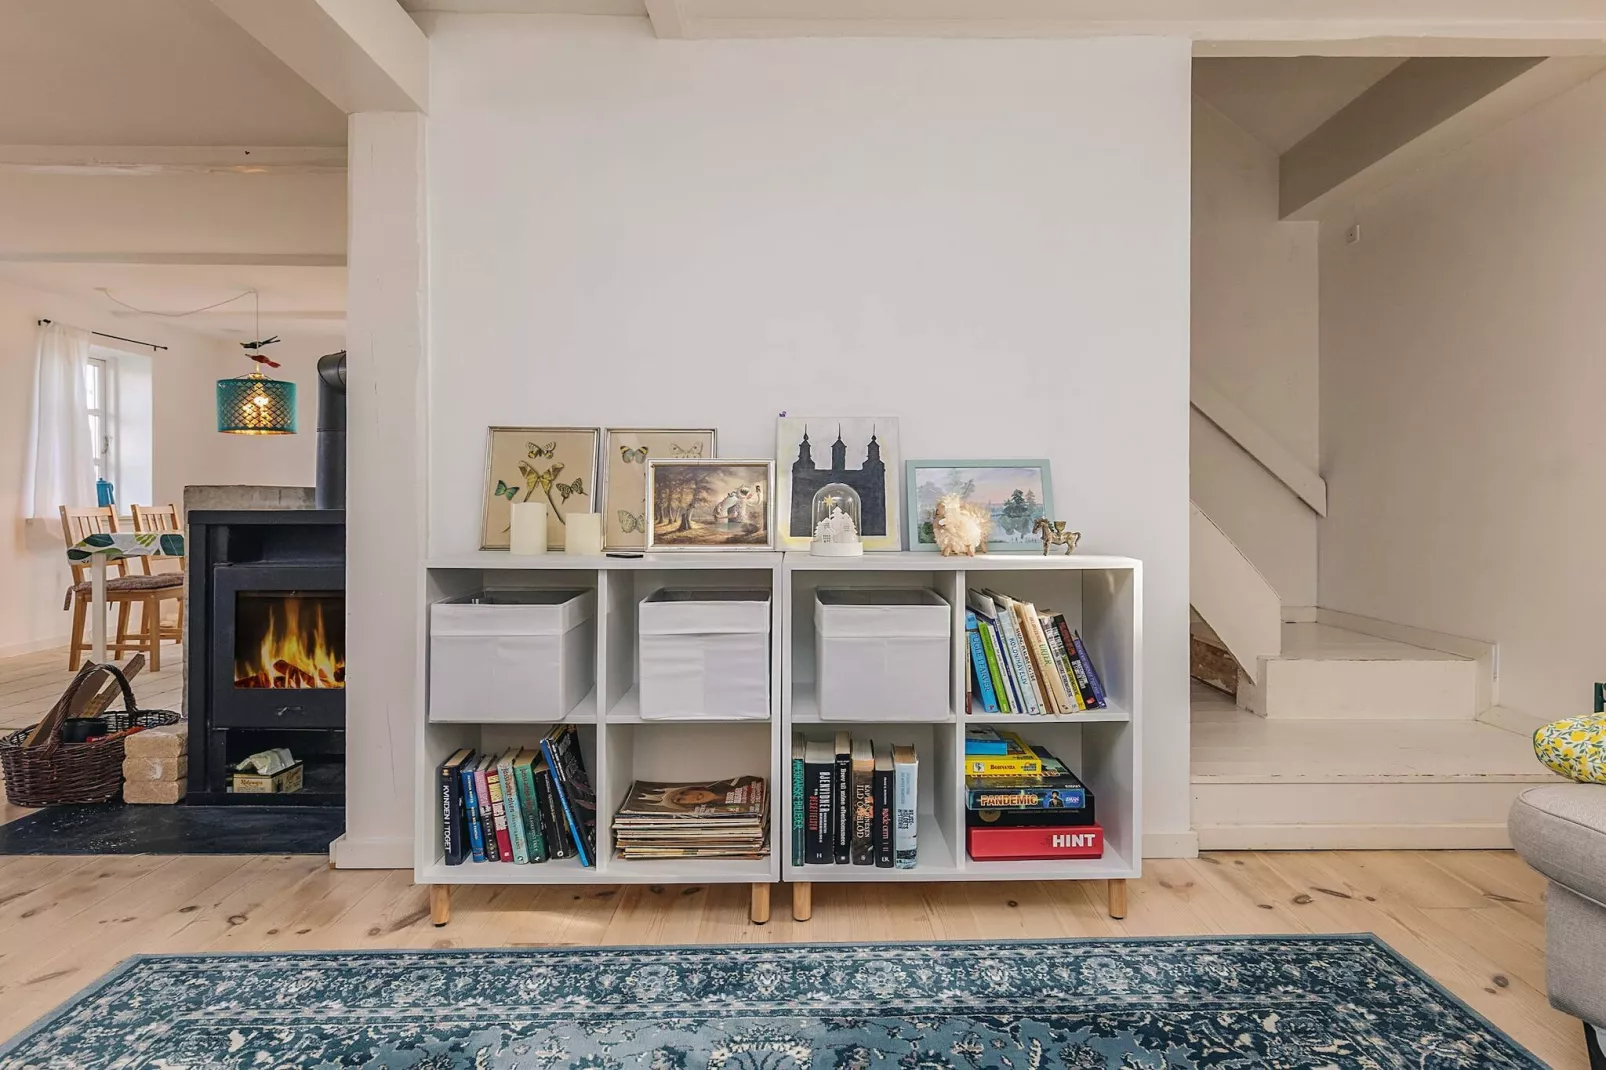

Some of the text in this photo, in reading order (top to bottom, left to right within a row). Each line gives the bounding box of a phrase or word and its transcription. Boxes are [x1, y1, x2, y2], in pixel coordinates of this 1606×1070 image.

[978, 662, 990, 692] FARVER
[793, 760, 804, 830] AMERIKANSKE BILLEDER
[819, 772, 830, 812] ØJENVIDNER
[856, 785, 864, 799] ILD
[980, 794, 1038, 806] PANDEMIC
[1052, 833, 1096, 848] HINT
